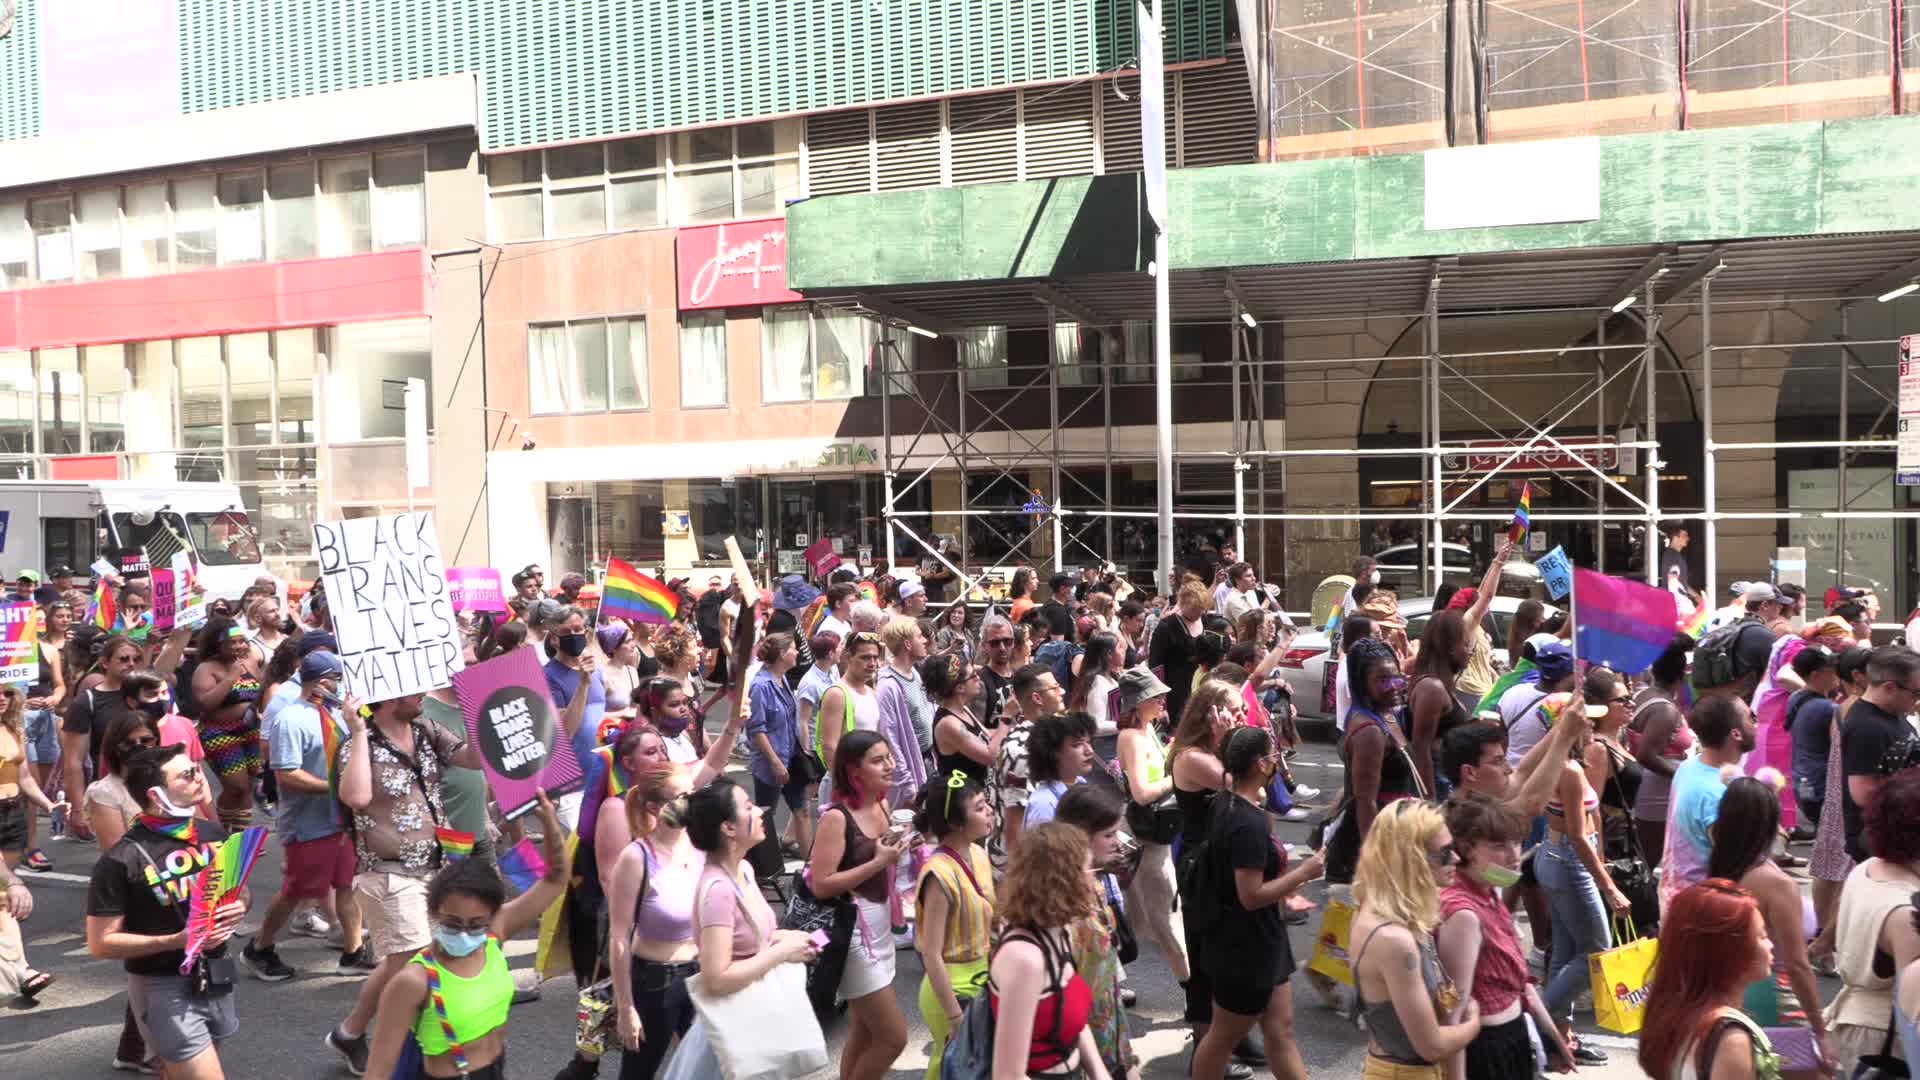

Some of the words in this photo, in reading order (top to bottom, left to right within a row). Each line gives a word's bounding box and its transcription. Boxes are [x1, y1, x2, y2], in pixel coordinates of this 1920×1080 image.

[313, 512, 435, 571] BLACK
[323, 555, 444, 610] TRANS
[333, 599, 452, 657] LIVES
[343, 642, 458, 699] MATTER
